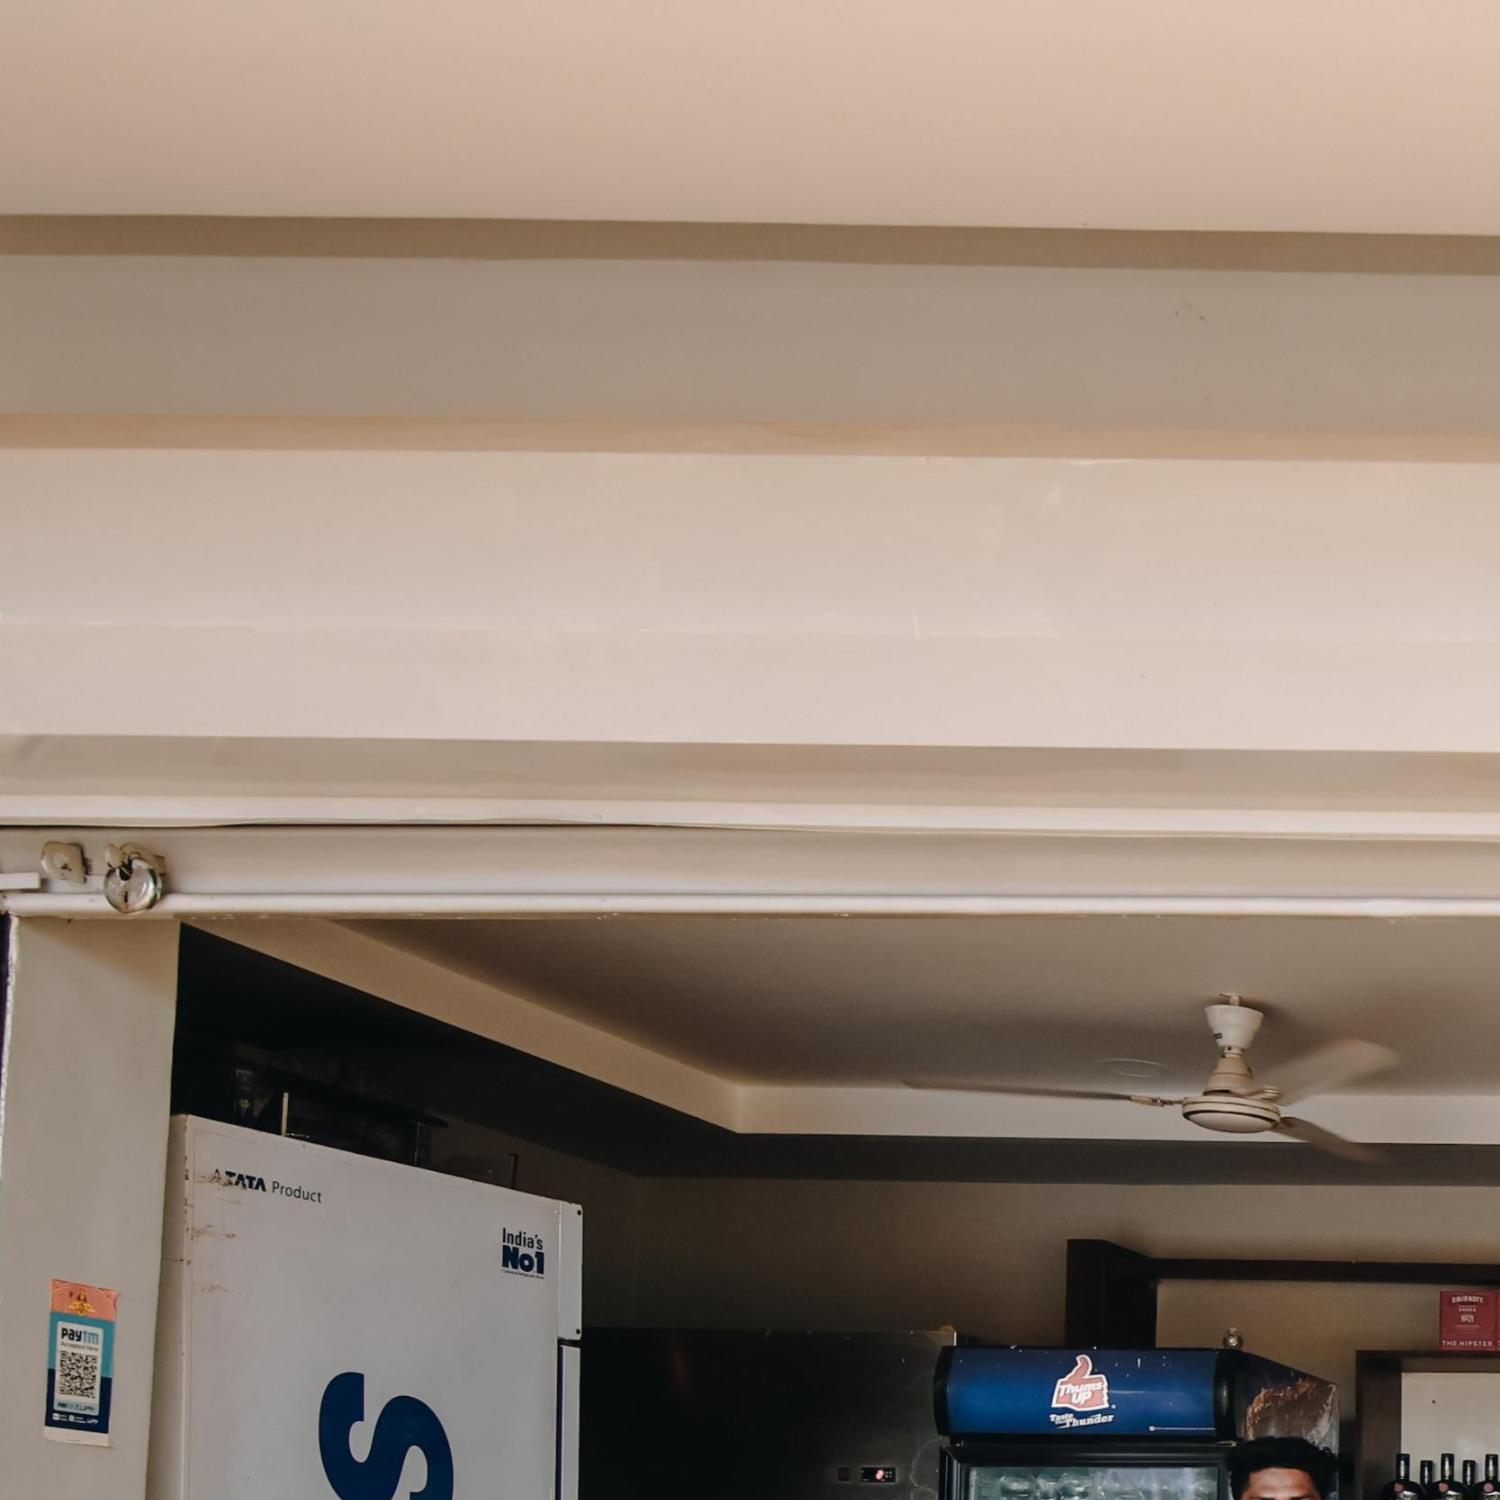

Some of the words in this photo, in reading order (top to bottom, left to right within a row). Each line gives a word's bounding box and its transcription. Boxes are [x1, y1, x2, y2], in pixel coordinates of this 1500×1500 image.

[225, 1170, 267, 1192] TATA
[272, 1180, 322, 1204] Product
[502, 1227, 543, 1251] India's
[502, 1244, 544, 1275] No1
[1452, 1296, 1485, 1304] SMIRNOFF
[1059, 1382, 1105, 1398] Thums
[1066, 1414, 1115, 1428] Thunder
